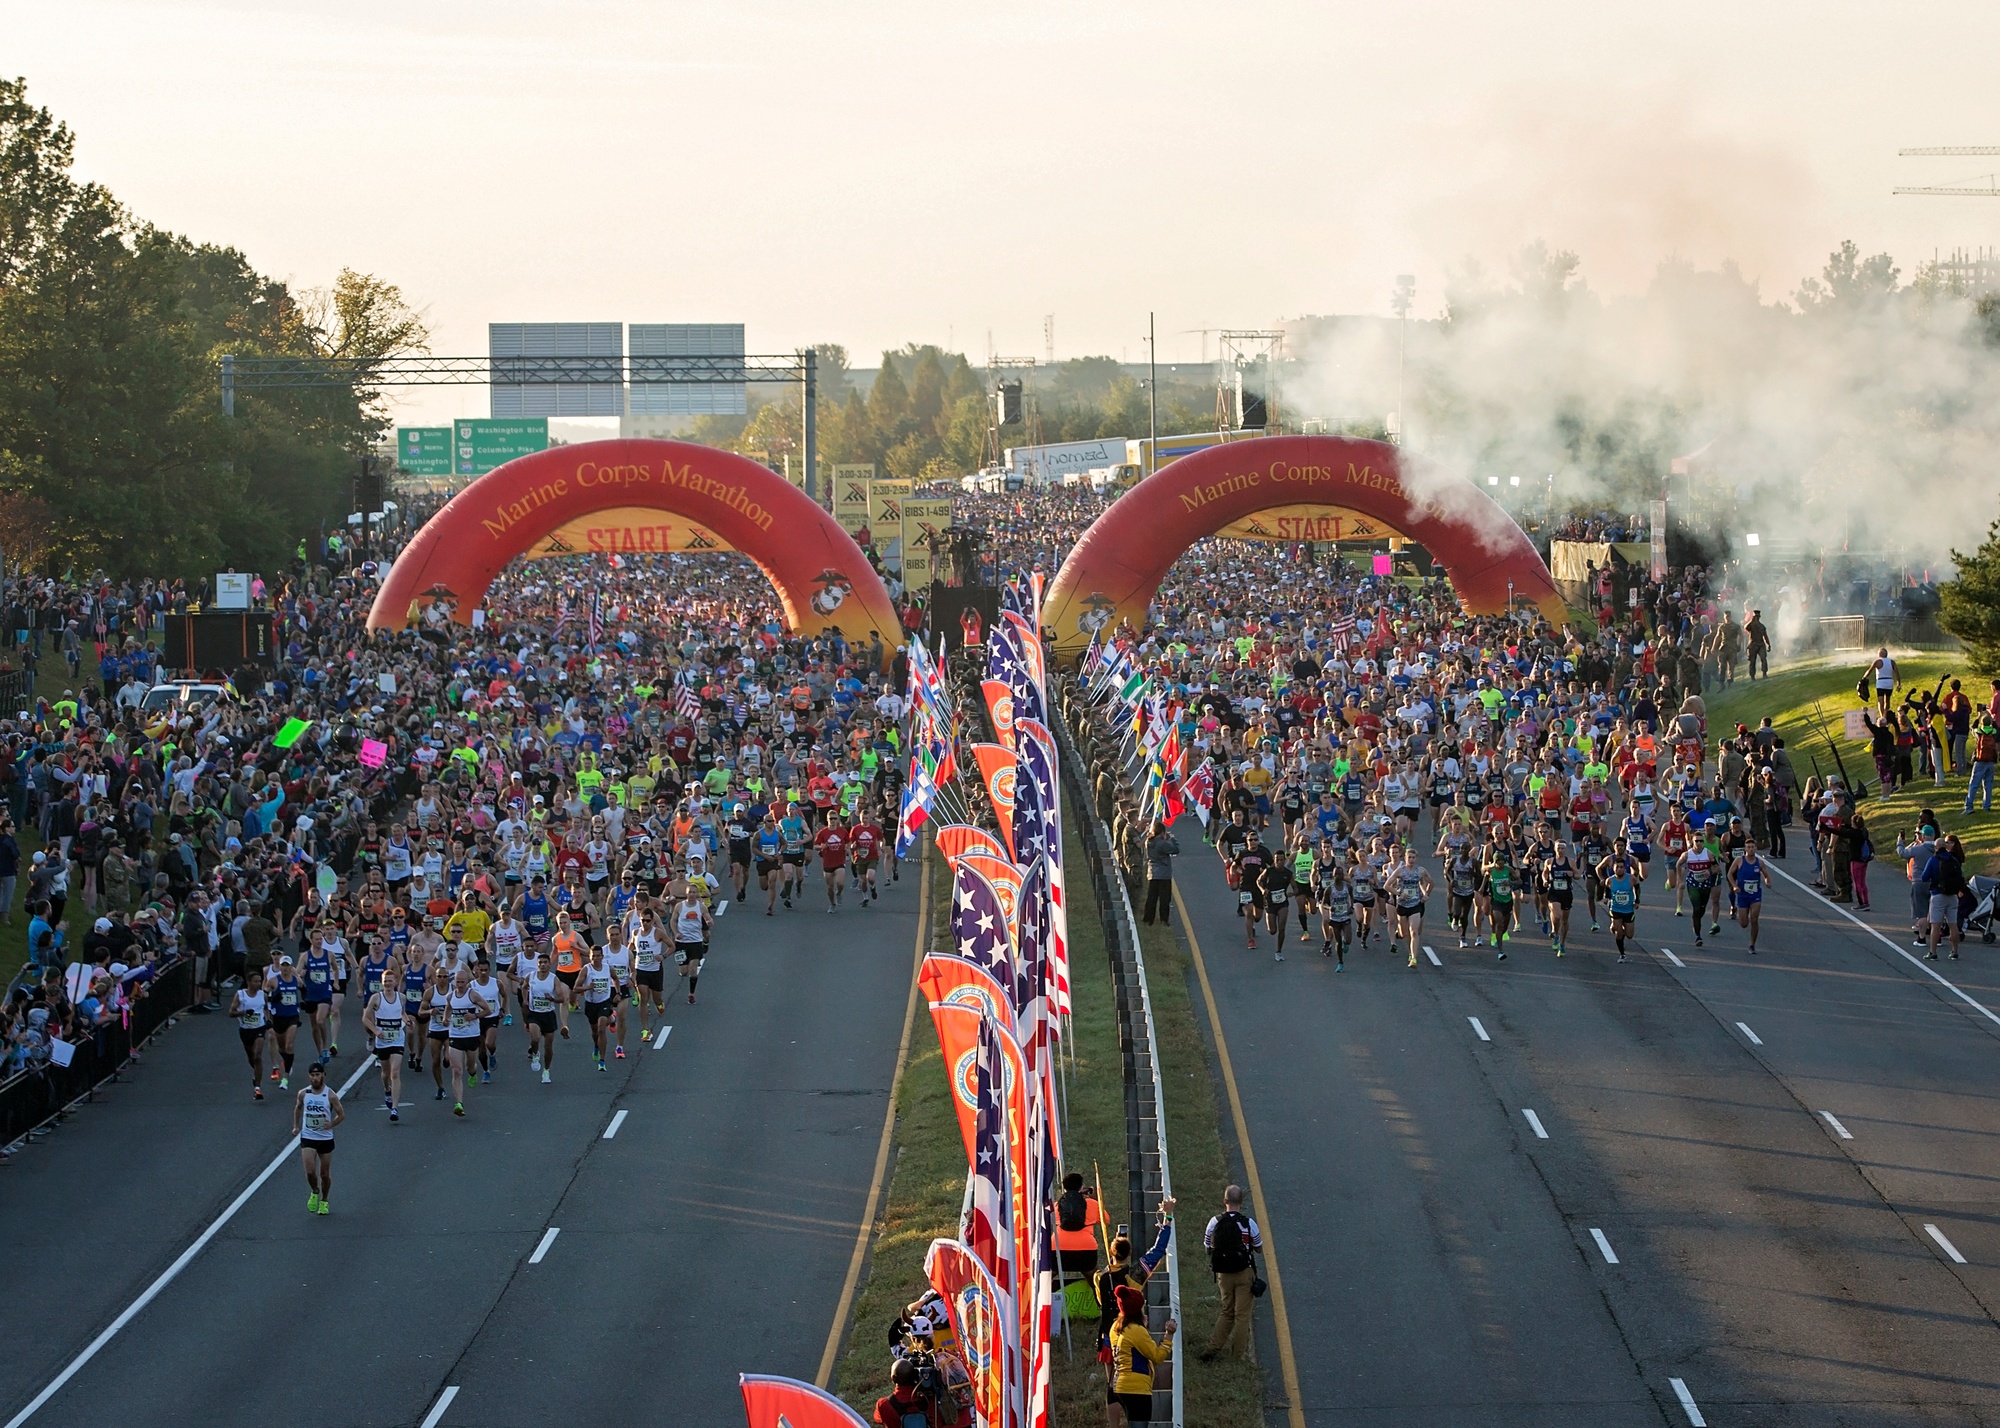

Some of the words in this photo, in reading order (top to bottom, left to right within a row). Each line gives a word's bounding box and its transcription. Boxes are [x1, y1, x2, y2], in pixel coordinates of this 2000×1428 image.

[402, 458, 449, 466] Washington
[1048, 444, 1108, 465] nomad
[873, 485, 910, 496] 2:30-2:59
[1178, 471, 1260, 514] Marine
[1270, 461, 1332, 486] Corps
[481, 478, 568, 540] Marine
[576, 462, 650, 488] Corps
[660, 460, 774, 532] Marathon
[905, 506, 924, 517] BIBS
[926, 506, 950, 516] 1-499
[1278, 516, 1343, 540] START
[587, 525, 672, 553] START
[906, 559, 926, 570] BIBS
